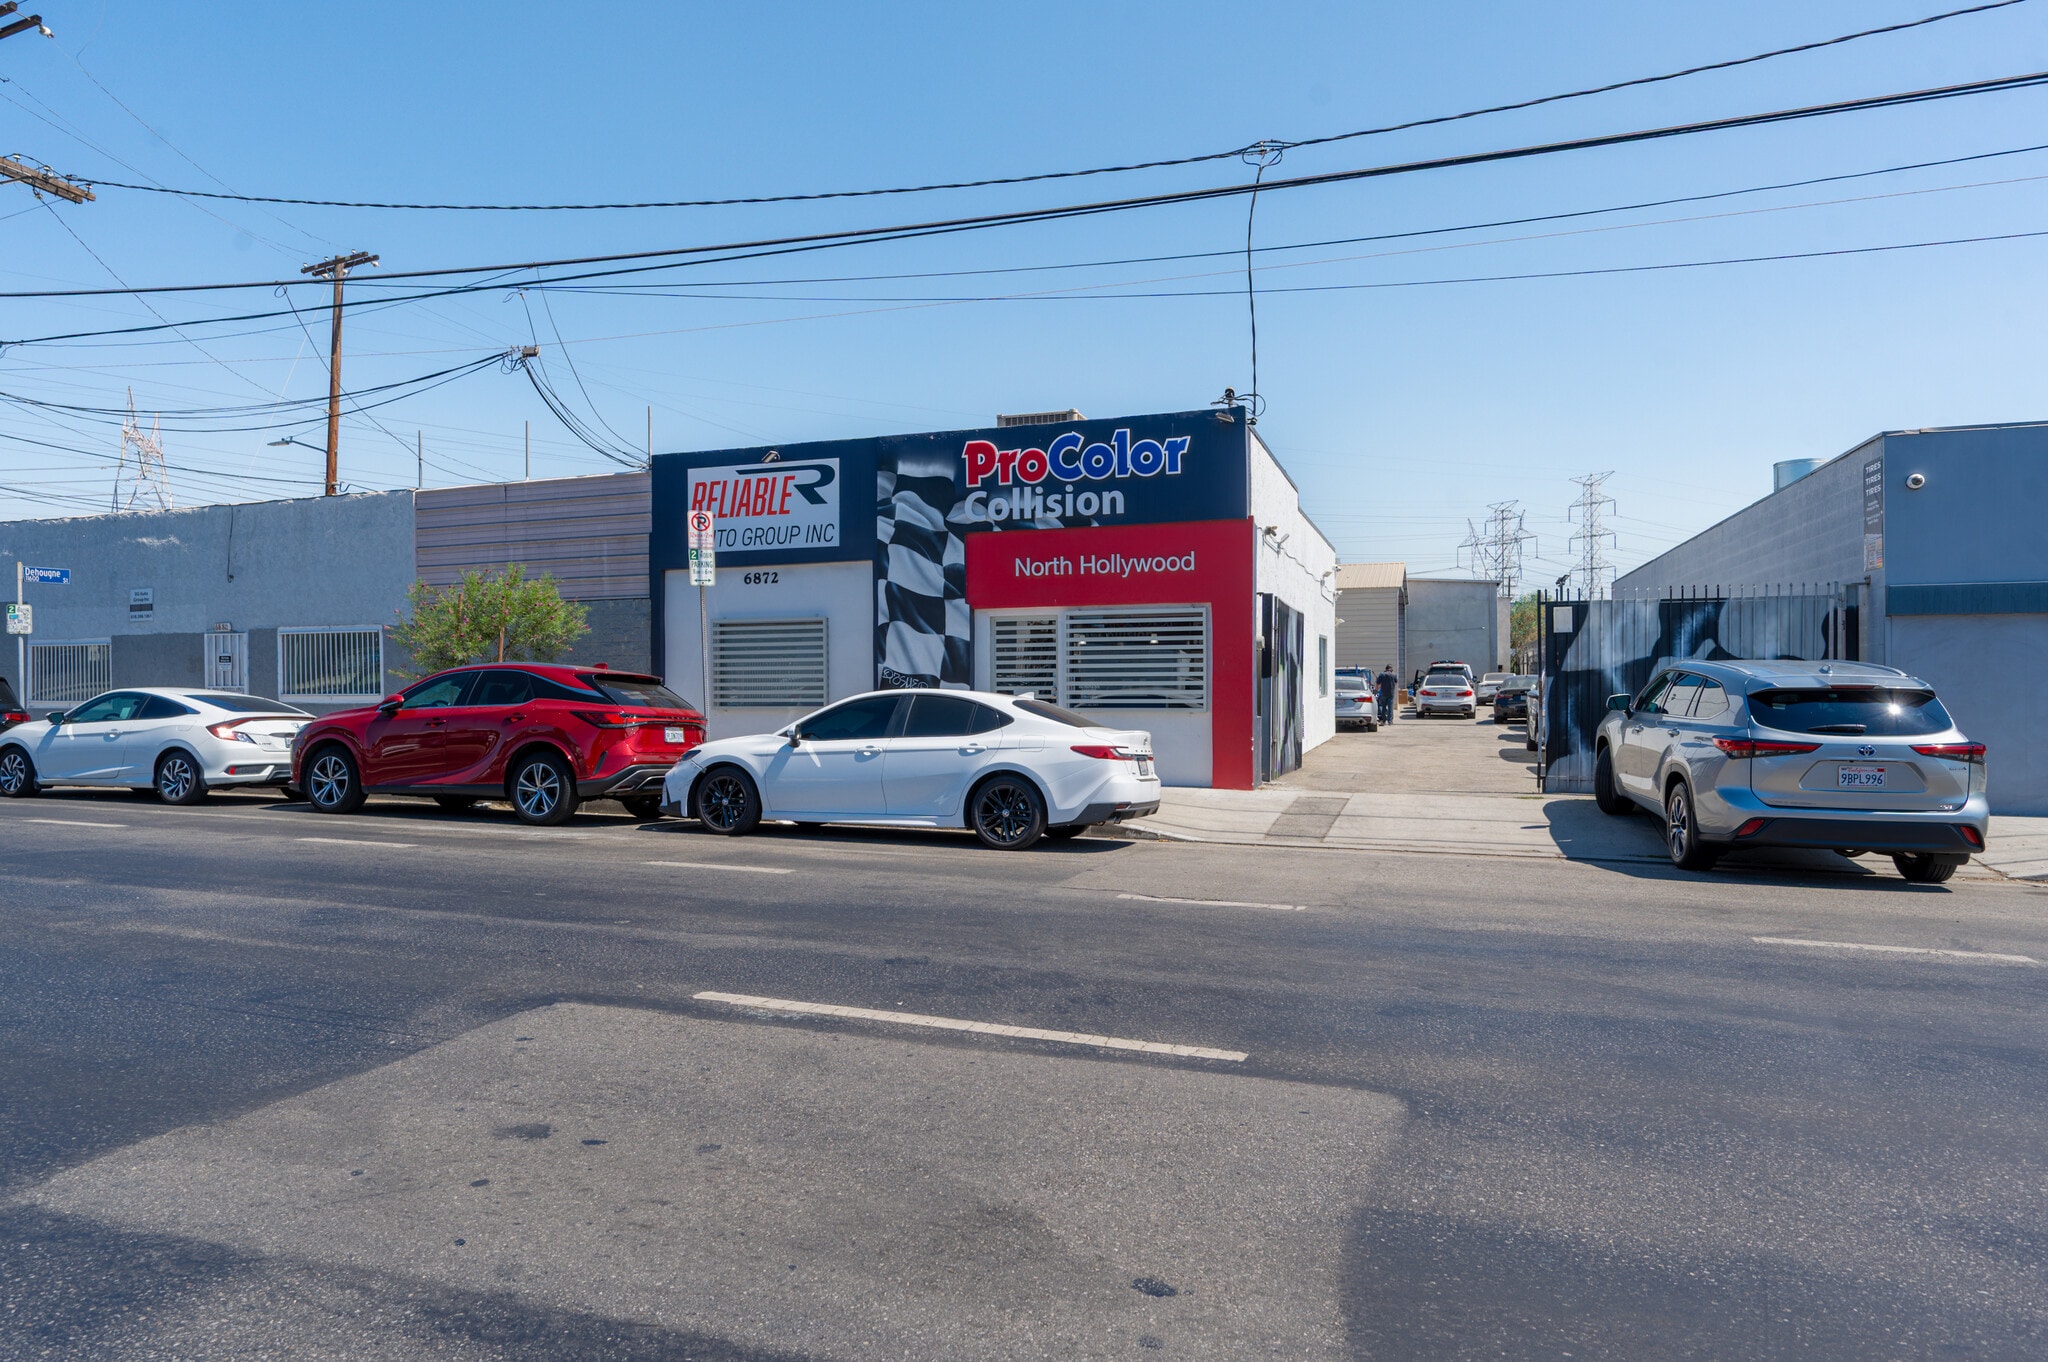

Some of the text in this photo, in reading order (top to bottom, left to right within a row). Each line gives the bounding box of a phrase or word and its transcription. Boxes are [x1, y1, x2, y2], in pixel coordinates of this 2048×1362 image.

[962, 428, 1191, 488] ProColor
[1865, 461, 1881, 474] TIRES
[1865, 473, 1881, 485] TIRES
[691, 475, 796, 519] RELIABLE
[1865, 485, 1881, 496] TIRES
[964, 484, 1125, 522] Collision
[713, 523, 835, 548] TO GROUP INC
[691, 550, 697, 559] 2
[1014, 551, 1195, 578] North Hollywood
[24, 567, 61, 579] Dehougne
[743, 571, 779, 585] 6872
[1841, 774, 1883, 784] 9BPL996
